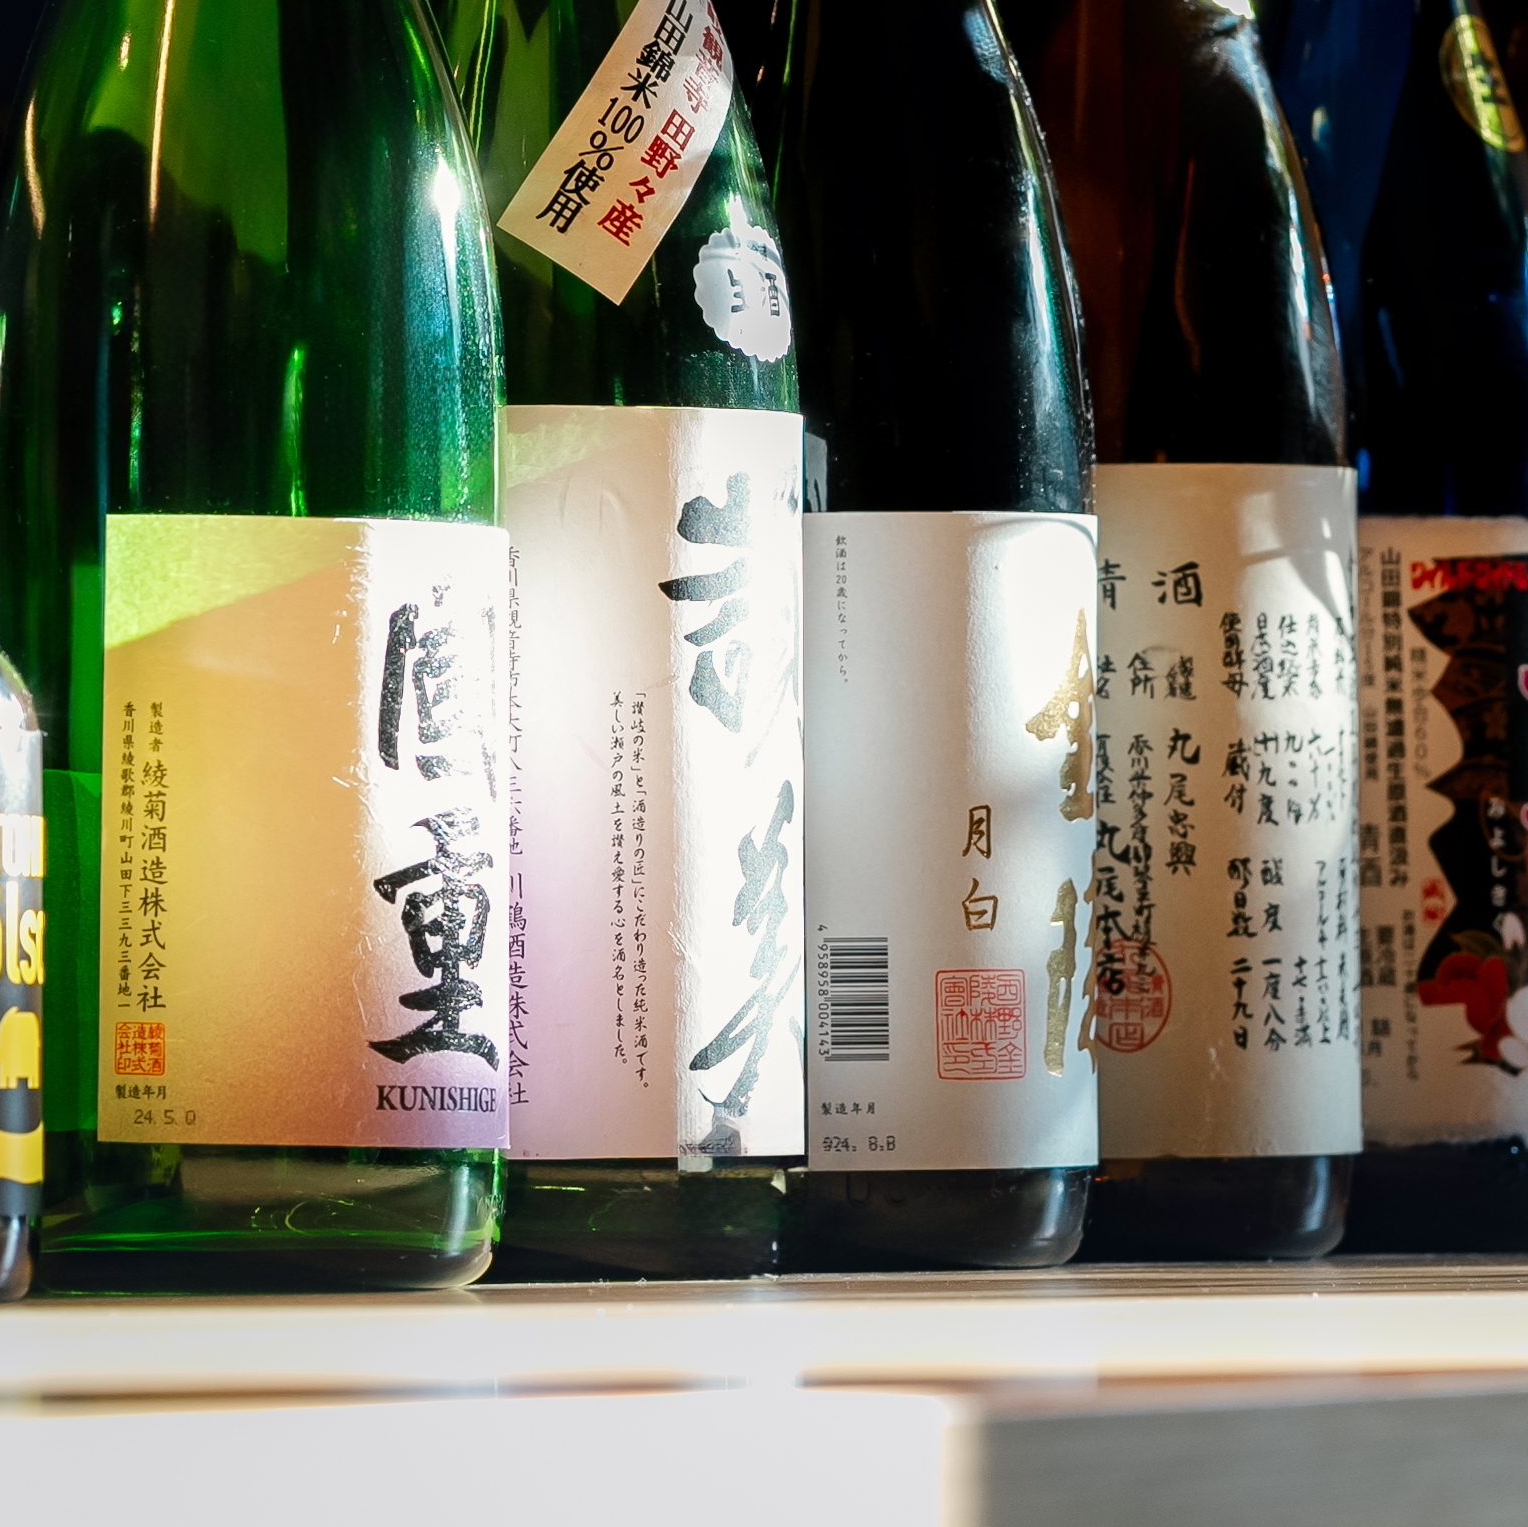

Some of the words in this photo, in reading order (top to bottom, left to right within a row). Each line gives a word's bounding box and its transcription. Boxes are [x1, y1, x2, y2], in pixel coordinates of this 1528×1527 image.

[148, 701, 165, 754] 製造者
[136, 758, 170, 1013] 綾菊酒造株式会社
[961, 804, 999, 933] 月白
[817, 943, 830, 998] 958958
[818, 1003, 831, 1058] 004143
[115, 1084, 167, 1101] 製造年月
[376, 1084, 497, 1113] KUNISHIGE
[820, 1101, 877, 1117] 製造年月
